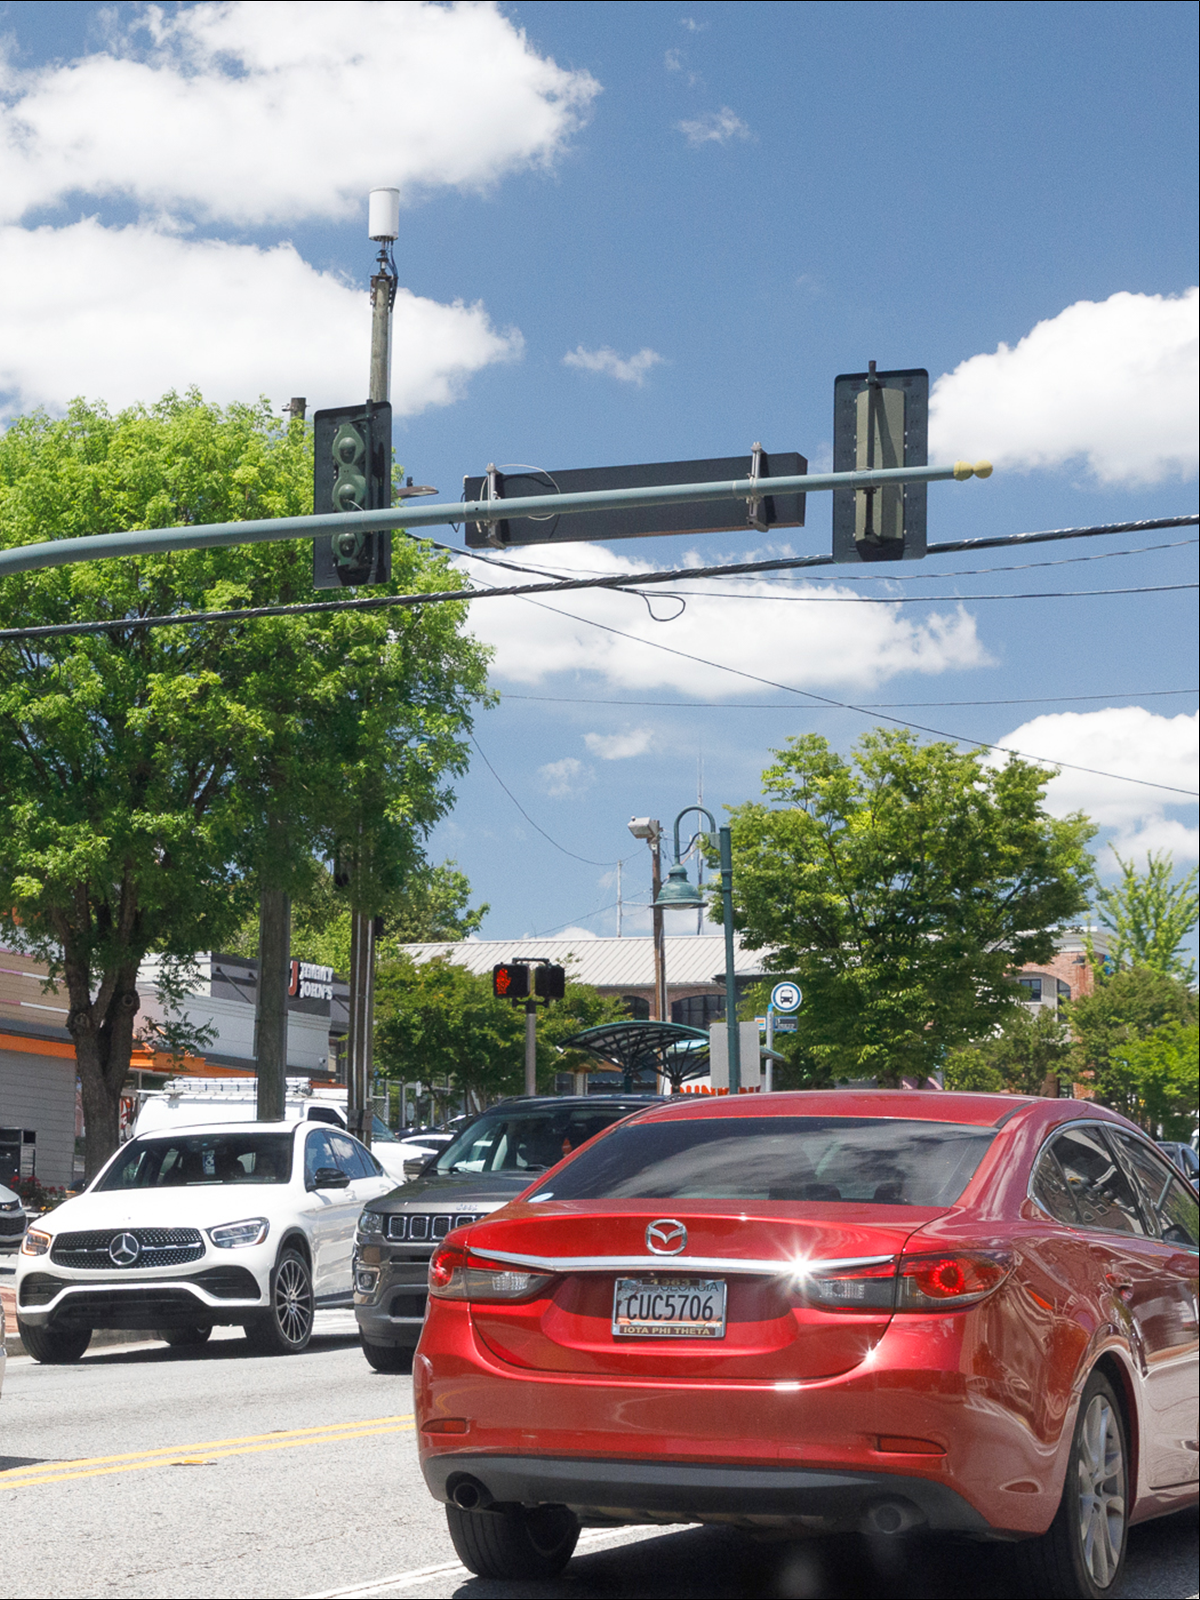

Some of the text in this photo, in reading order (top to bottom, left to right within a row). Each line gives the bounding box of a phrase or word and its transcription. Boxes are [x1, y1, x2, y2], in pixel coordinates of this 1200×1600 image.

[299, 962, 334, 982] JIMMY
[299, 981, 333, 1000] JOHN'S
[626, 1294, 714, 1321] CUC5706
[623, 1326, 649, 1334] IOTA
[674, 1327, 710, 1335] THETA
